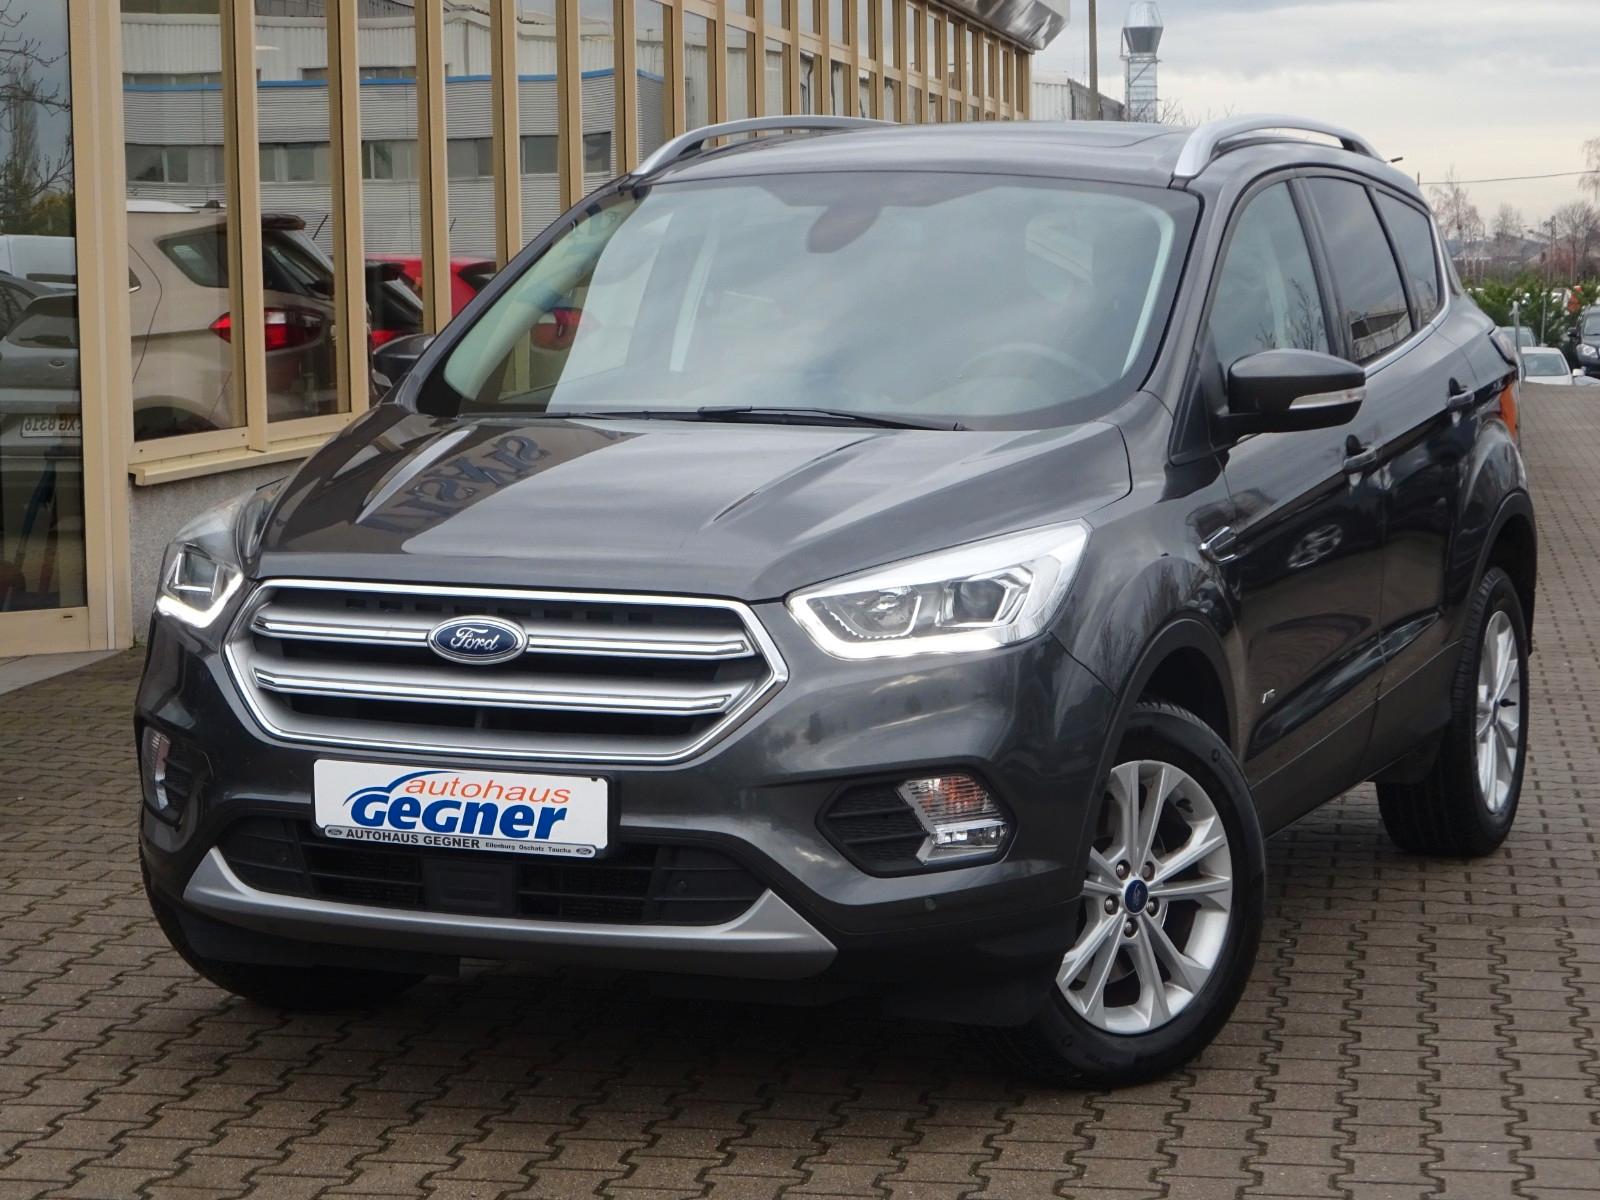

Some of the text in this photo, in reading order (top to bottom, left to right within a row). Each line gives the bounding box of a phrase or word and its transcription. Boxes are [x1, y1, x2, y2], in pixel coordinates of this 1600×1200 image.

[450, 627, 500, 651] Ford
[404, 776, 571, 805] autohaus
[346, 828, 418, 844] AUTOHAUS
[423, 835, 480, 849] GEGNER
[548, 846, 571, 854] Taucha
